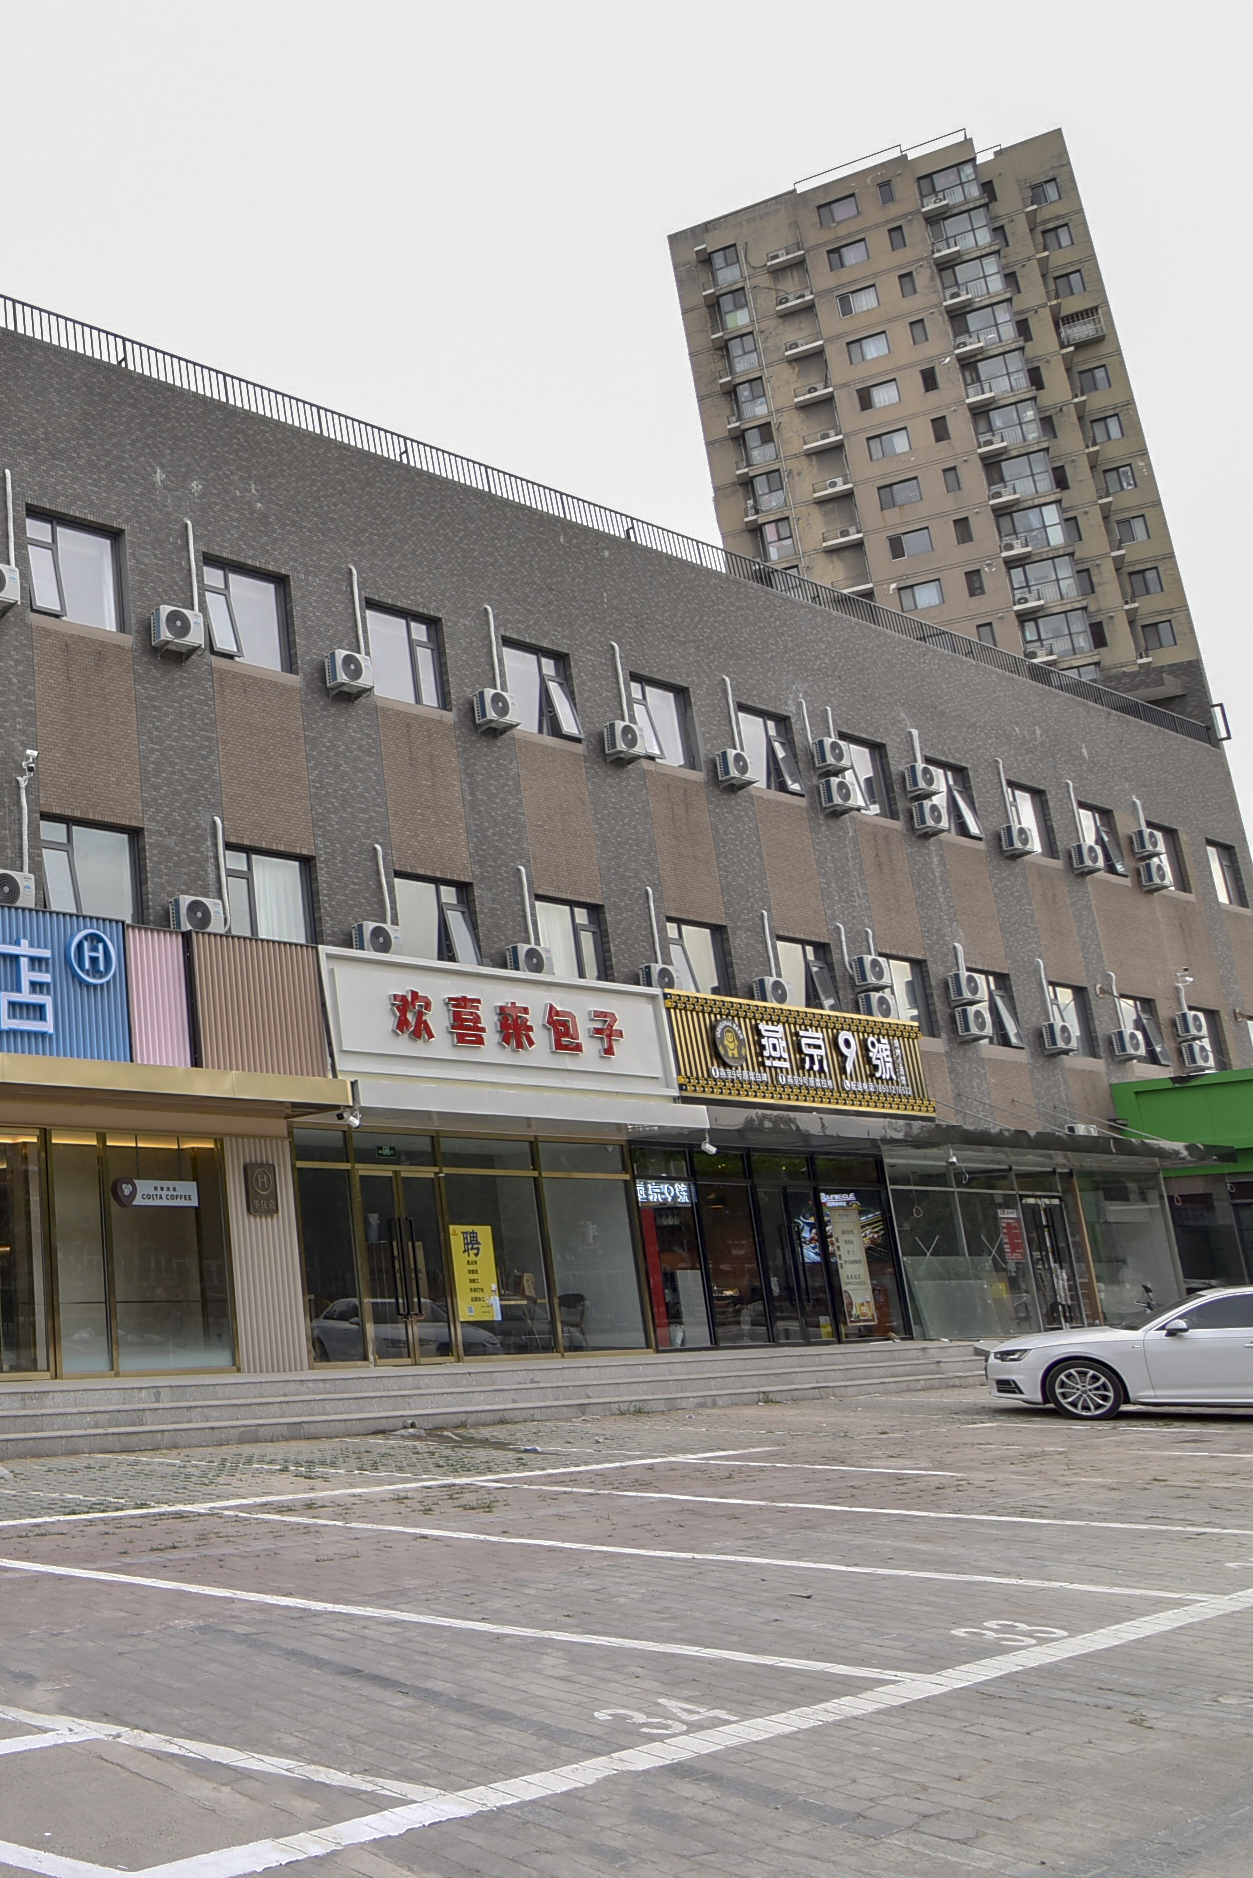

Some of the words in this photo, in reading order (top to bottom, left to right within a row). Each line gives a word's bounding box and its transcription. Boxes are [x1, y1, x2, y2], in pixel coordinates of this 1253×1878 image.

[388, 988, 624, 1058] 欢喜来包子
[141, 1193, 164, 1202] COSTA
[165, 1193, 193, 1202] COFFEE
[460, 1228, 482, 1258] 聘
[950, 1620, 1068, 1646] 33
[593, 1697, 741, 1734] 34
